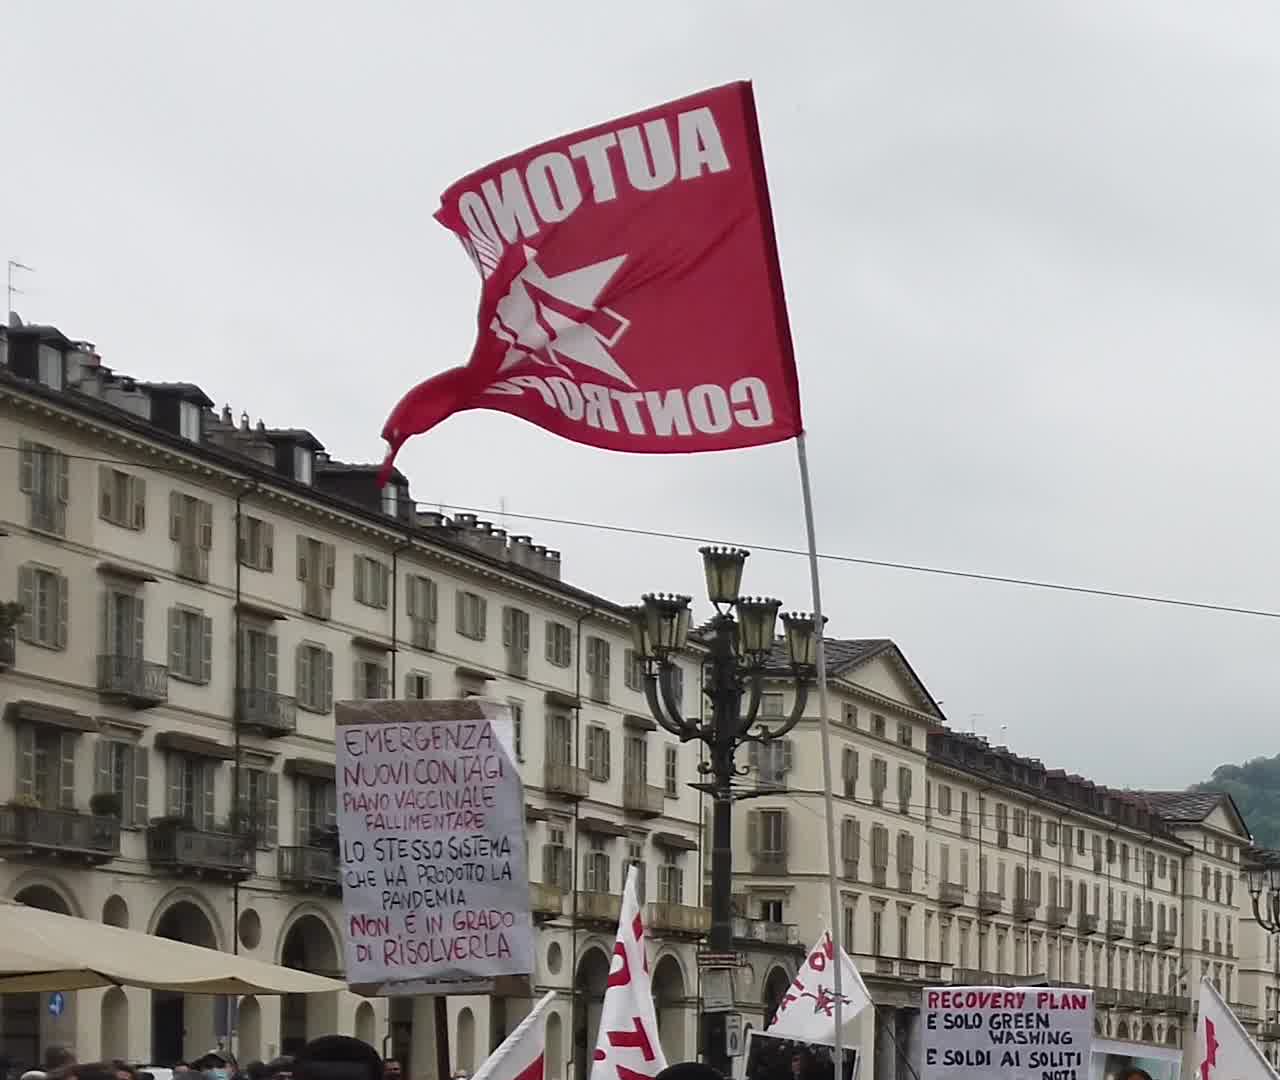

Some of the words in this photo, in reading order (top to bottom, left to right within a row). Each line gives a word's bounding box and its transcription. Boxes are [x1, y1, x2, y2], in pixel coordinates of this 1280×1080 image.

[344, 721, 494, 757] EMERGENZA
[343, 760, 409, 788] NUOVI
[414, 754, 505, 786] CONTAGI
[343, 791, 390, 813] PIANO
[394, 785, 497, 810] VACCINALE
[364, 810, 486, 832] FALLIMENTARE
[344, 840, 365, 864] LO
[373, 836, 444, 862] STESSO
[345, 869, 377, 889] CHE
[383, 864, 408, 888] HA
[417, 862, 486, 886] PRODOTTO
[491, 861, 513, 882] LA
[381, 888, 467, 911] PANDEMIA
[350, 913, 390, 937] NON
[425, 914, 444, 934] IN
[452, 909, 515, 931] GRADO
[927, 991, 1026, 1010] RECOVERY
[1036, 992, 1088, 1011] PLAN
[943, 1013, 983, 1030] SOLO
[988, 1012, 1050, 1030] GREEN
[988, 1030, 1073, 1046] WASHING
[942, 1049, 991, 1067] SOLDI
[1000, 1051, 1020, 1067] AI
[1027, 1051, 1082, 1069] SOLITI
